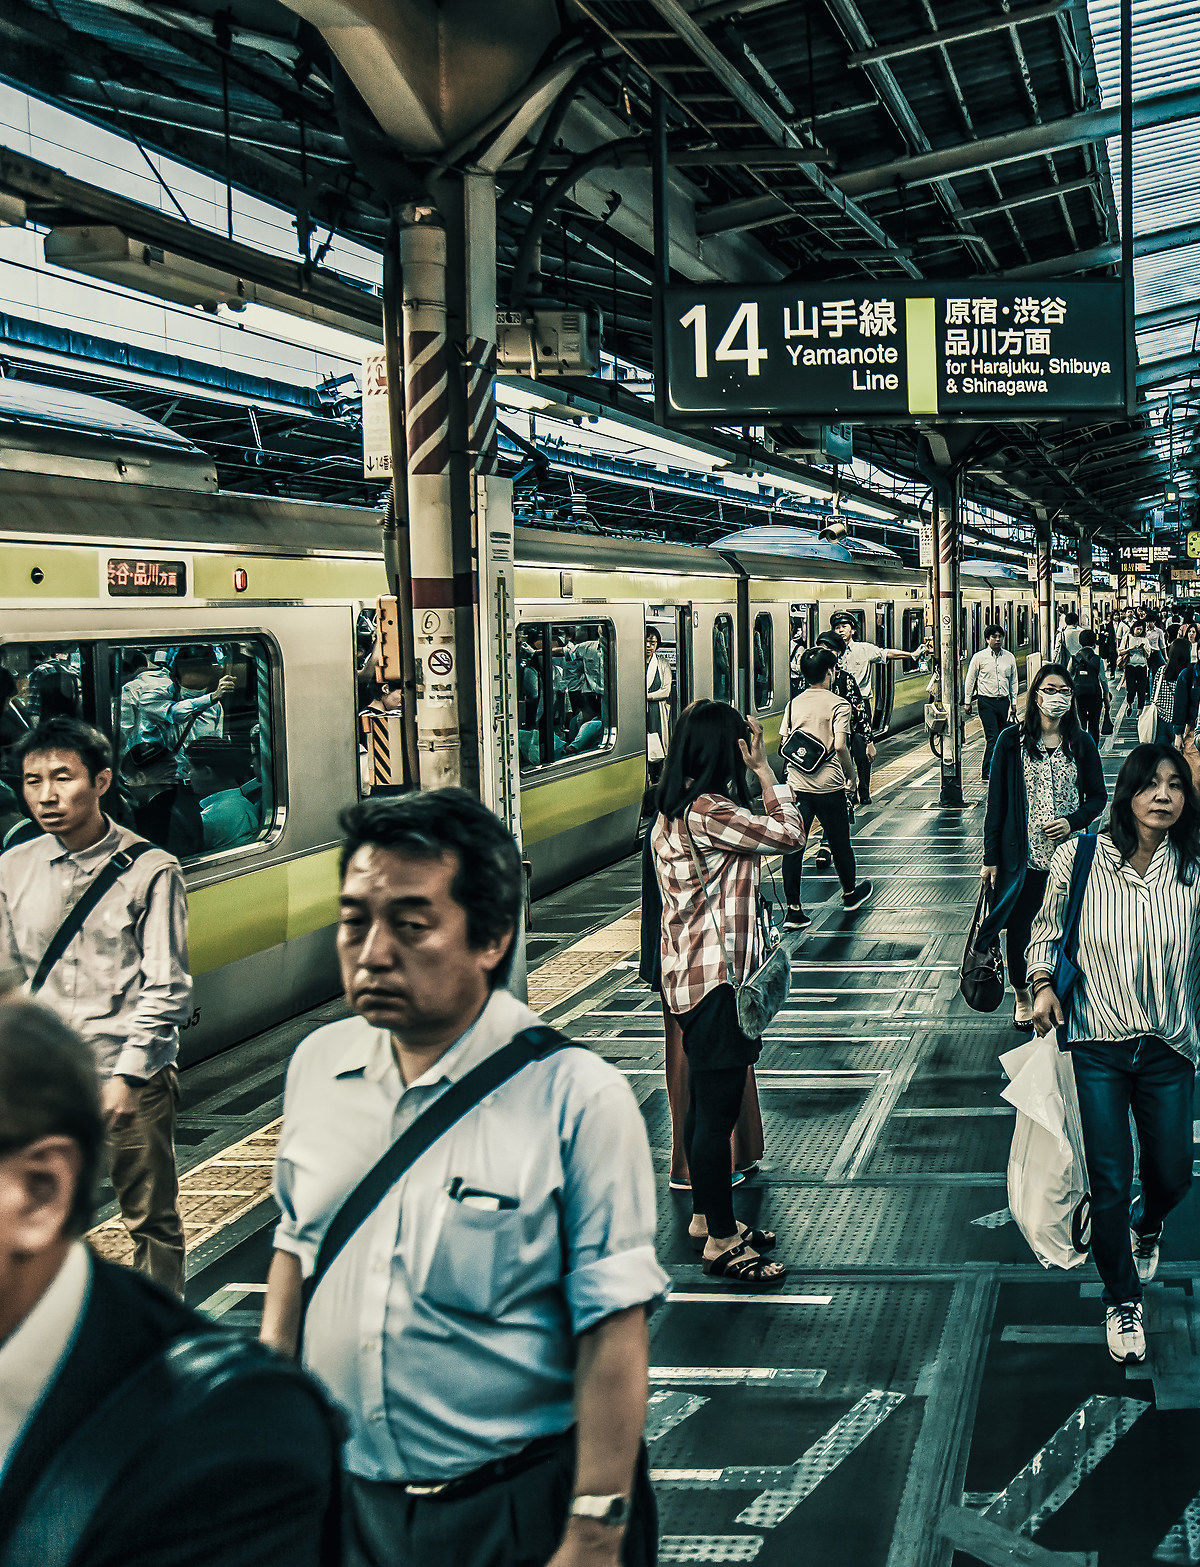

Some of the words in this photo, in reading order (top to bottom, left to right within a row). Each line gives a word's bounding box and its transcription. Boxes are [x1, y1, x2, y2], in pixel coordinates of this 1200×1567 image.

[782, 298, 898, 340] 山手線
[944, 297, 1068, 326] 原宿・渋谷
[678, 301, 768, 378] 14
[944, 328, 1052, 357] 品川方面
[786, 343, 899, 366] Yamanote
[945, 360, 968, 375] for
[971, 360, 1045, 379] Harajuku,
[1048, 358, 1111, 378] Shibuya
[853, 369, 899, 391] Line
[945, 379, 958, 394] &
[962, 377, 1048, 395] Shinagawa
[375, 455, 393, 471] 14番
[1118, 547, 1131, 559] 14
